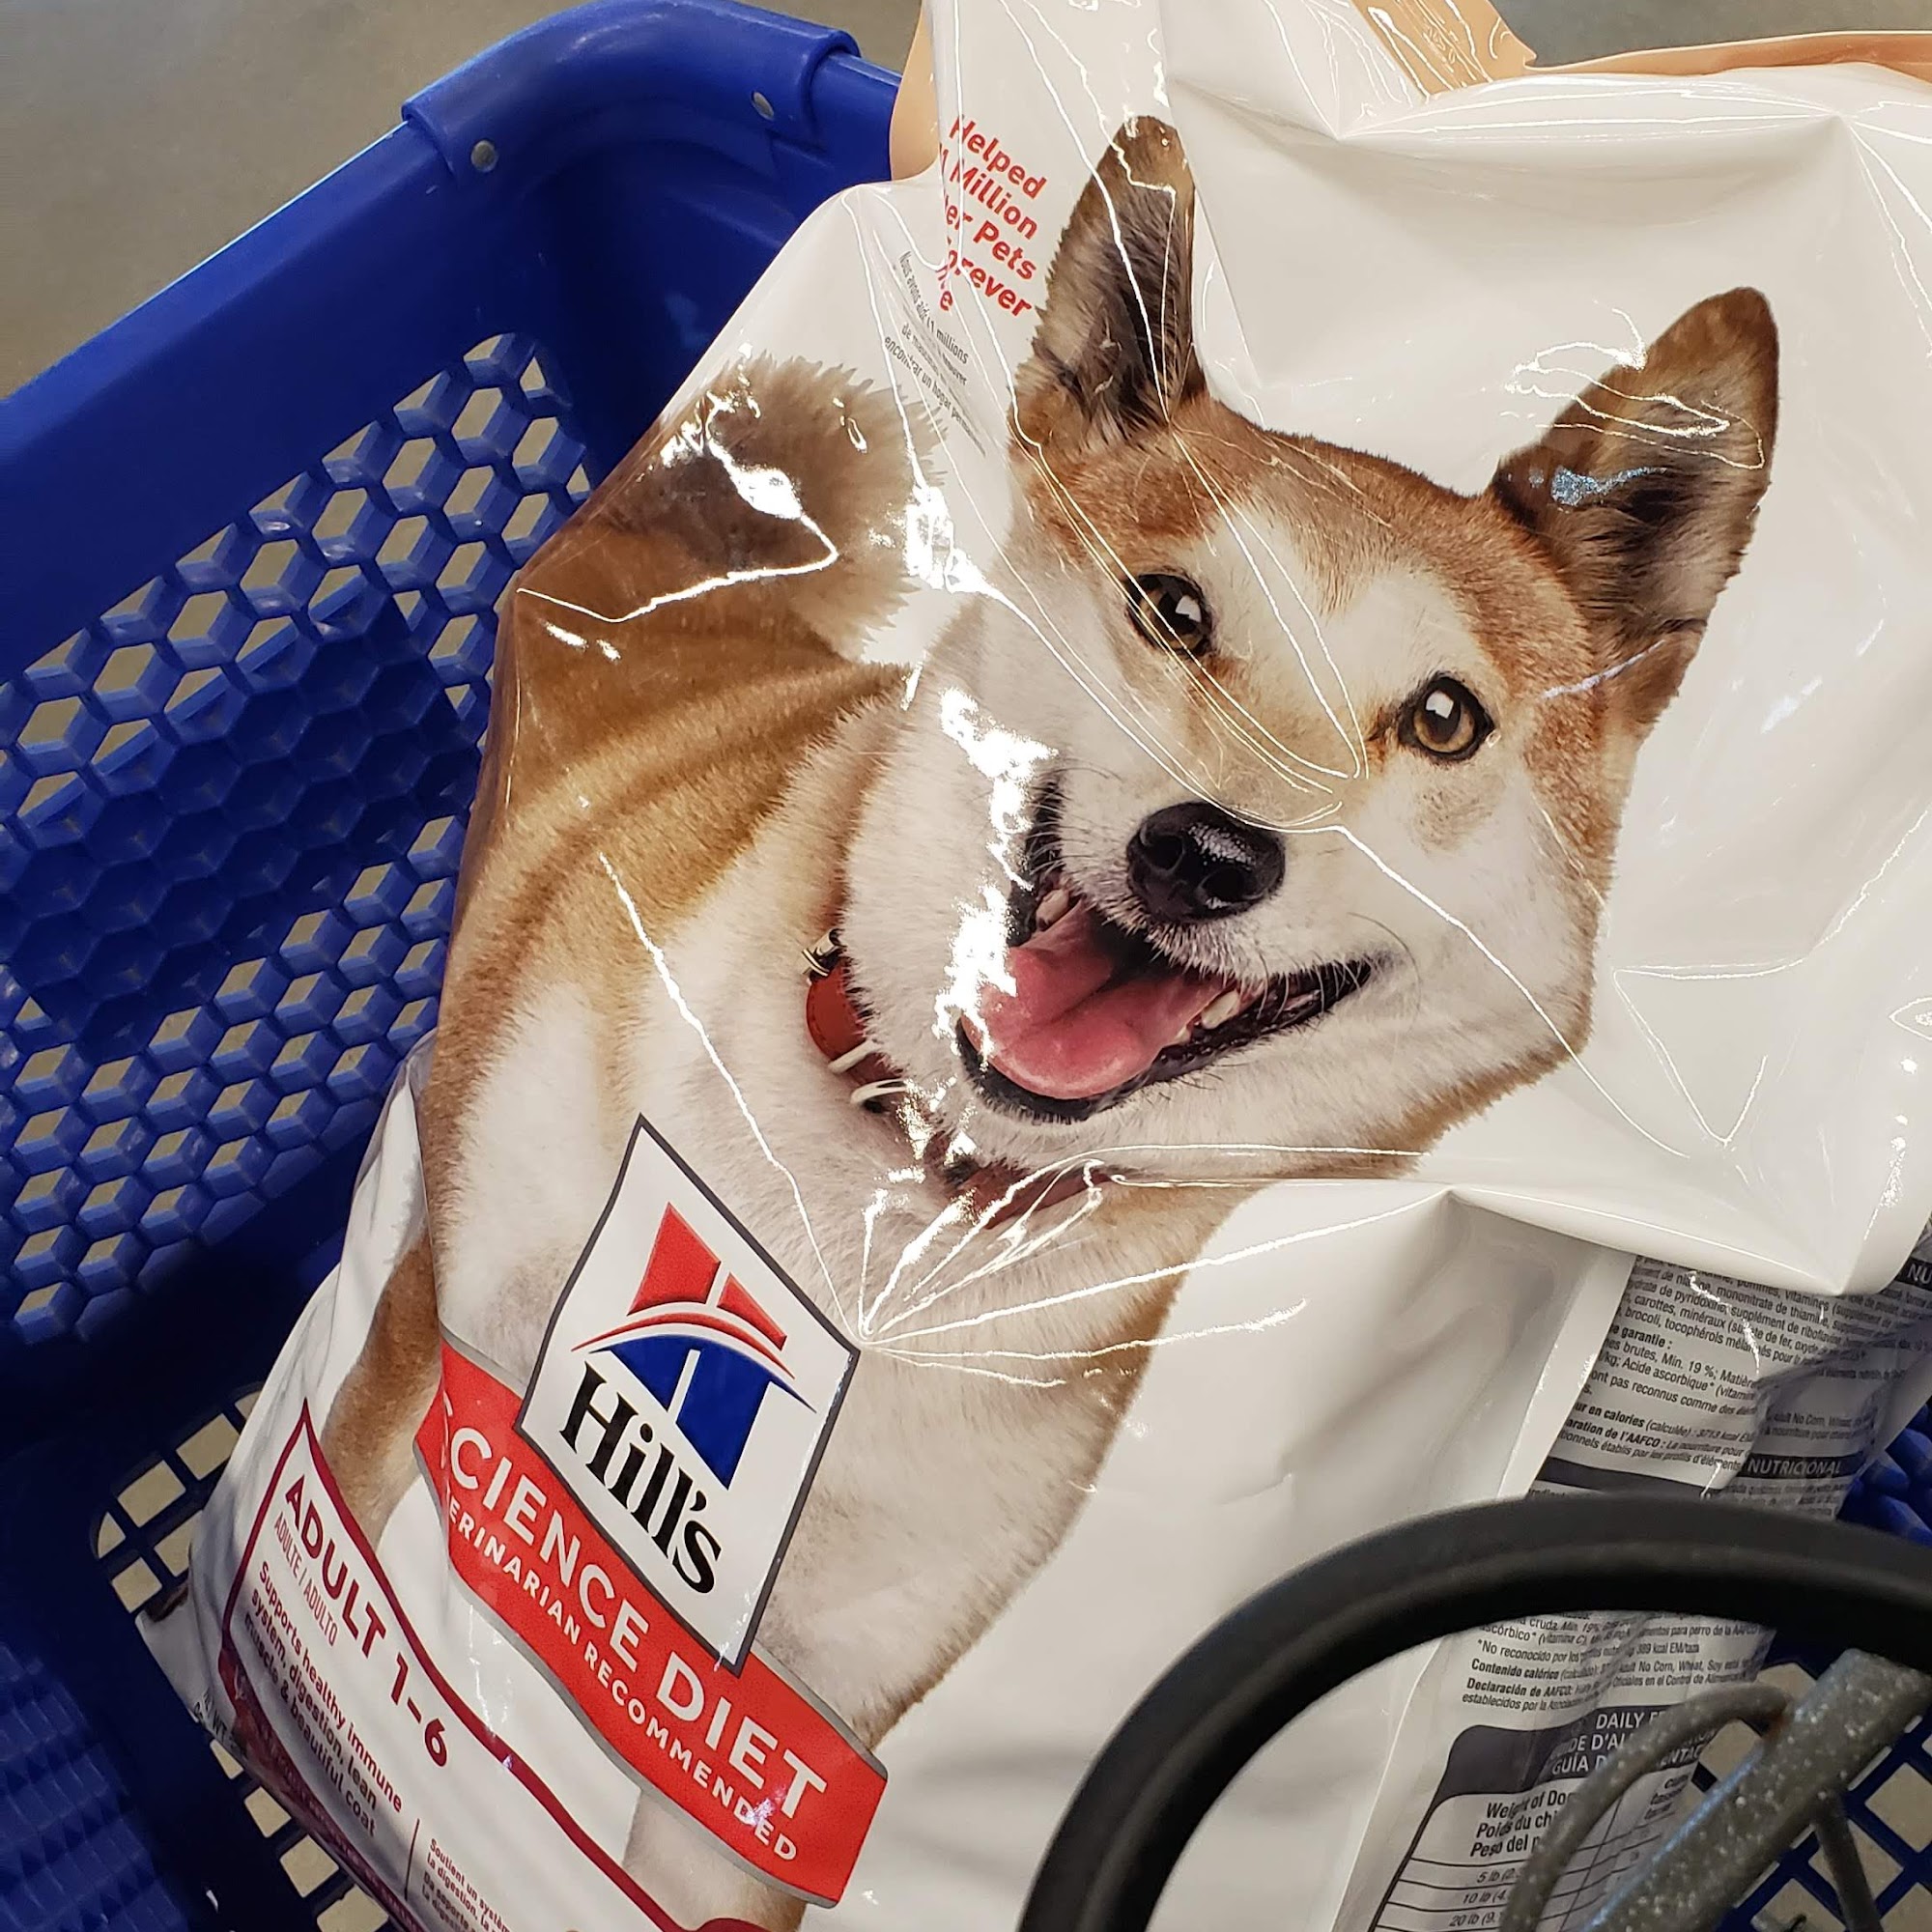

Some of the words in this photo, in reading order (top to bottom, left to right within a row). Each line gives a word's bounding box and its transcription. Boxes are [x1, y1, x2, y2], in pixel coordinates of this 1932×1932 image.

[949, 114, 1047, 200] Helped
[950, 159, 1037, 240] Million
[973, 219, 1037, 280] Pets
[947, 247, 1032, 316] orever
[937, 328, 969, 364] millions
[922, 372, 932, 388] un
[932, 381, 951, 409] hogar
[1676, 1272, 1711, 1293] niane,
[1717, 1285, 1773, 1310] mononitrate
[1776, 1301, 1787, 1315] de
[1634, 1293, 1676, 1317] carottes,
[1680, 1307, 1725, 1328] minéraux
[1765, 1331, 1777, 1345] de
[1779, 1333, 1792, 1349] fer,
[1660, 1284, 1672, 1297] de
[1730, 1305, 1785, 1331] supplément
[1787, 1321, 1799, 1334] de
[1621, 1325, 1665, 1349] garantie
[1625, 1306, 1662, 1328] brocoli,
[1664, 1317, 1723, 1345] tocophérols
[1773, 1348, 1794, 1366] pour
[1622, 1356, 1652, 1377] Acide
[1623, 1340, 1658, 1362] brutes,
[1662, 1351, 1684, 1370] Min.
[1689, 1361, 1701, 1376] 19
[1591, 1370, 1607, 1384] ont
[1610, 1375, 1629, 1390] pas
[1632, 1381, 1678, 1403] reconnus
[1680, 1394, 1717, 1413] comme
[1589, 1404, 1603, 1418] en
[1604, 1407, 1645, 1428] calories
[1605, 1426, 1618, 1440] de
[1620, 1428, 1661, 1449] l'AAFCO
[559, 1360, 722, 1594] Hill's
[274, 1512, 302, 1578] ADULTE
[303, 1578, 338, 1647] ADULTO
[285, 1473, 386, 1659] ADULT
[442, 1393, 649, 1673] CIENCE
[656, 1651, 828, 1819] DIET
[1471, 1658, 1522, 1678] Contenido
[1500, 1645, 1550, 1662] reconocido
[1552, 1652, 1567, 1664] por
[1638, 1660, 1651, 1673] No
[1654, 1660, 1675, 1674] Corn,
[1707, 1659, 1722, 1673] Soy
[260, 1560, 302, 1656] Supports
[302, 1648, 346, 1730] healthy
[348, 1721, 402, 1813] immune
[448, 1492, 582, 1644] ERINARIAN
[584, 1640, 797, 1861] RECOMMENDED
[1466, 1677, 1527, 1697] Declaración
[1529, 1687, 1542, 1697] de
[1645, 1676, 1656, 1688] en
[251, 1588, 287, 1668] system,
[289, 1663, 344, 1765] digestion,
[348, 1755, 378, 1810] lean
[1463, 1692, 1520, 1710] establecidos
[1521, 1700, 1538, 1713] por
[244, 1610, 279, 1685] muscle
[291, 1698, 343, 1791] beautiful
[345, 1788, 376, 1837] coat
[1596, 1711, 1644, 1730] DAILY
[1530, 1791, 1544, 1809] of
[1515, 1814, 1532, 1832] du
[1506, 1833, 1528, 1853] del
[430, 1838, 465, 1888] Soutient
[467, 1883, 478, 1902] un
[1476, 1871, 1488, 1884] 5
[427, 1852, 436, 1870] la
[438, 1866, 478, 1920] digestion,
[480, 1914, 490, 1932] la
[1463, 1892, 1478, 1904] 10
[1449, 1914, 1466, 1927] 20
[1467, 1913, 1479, 1924] lb
